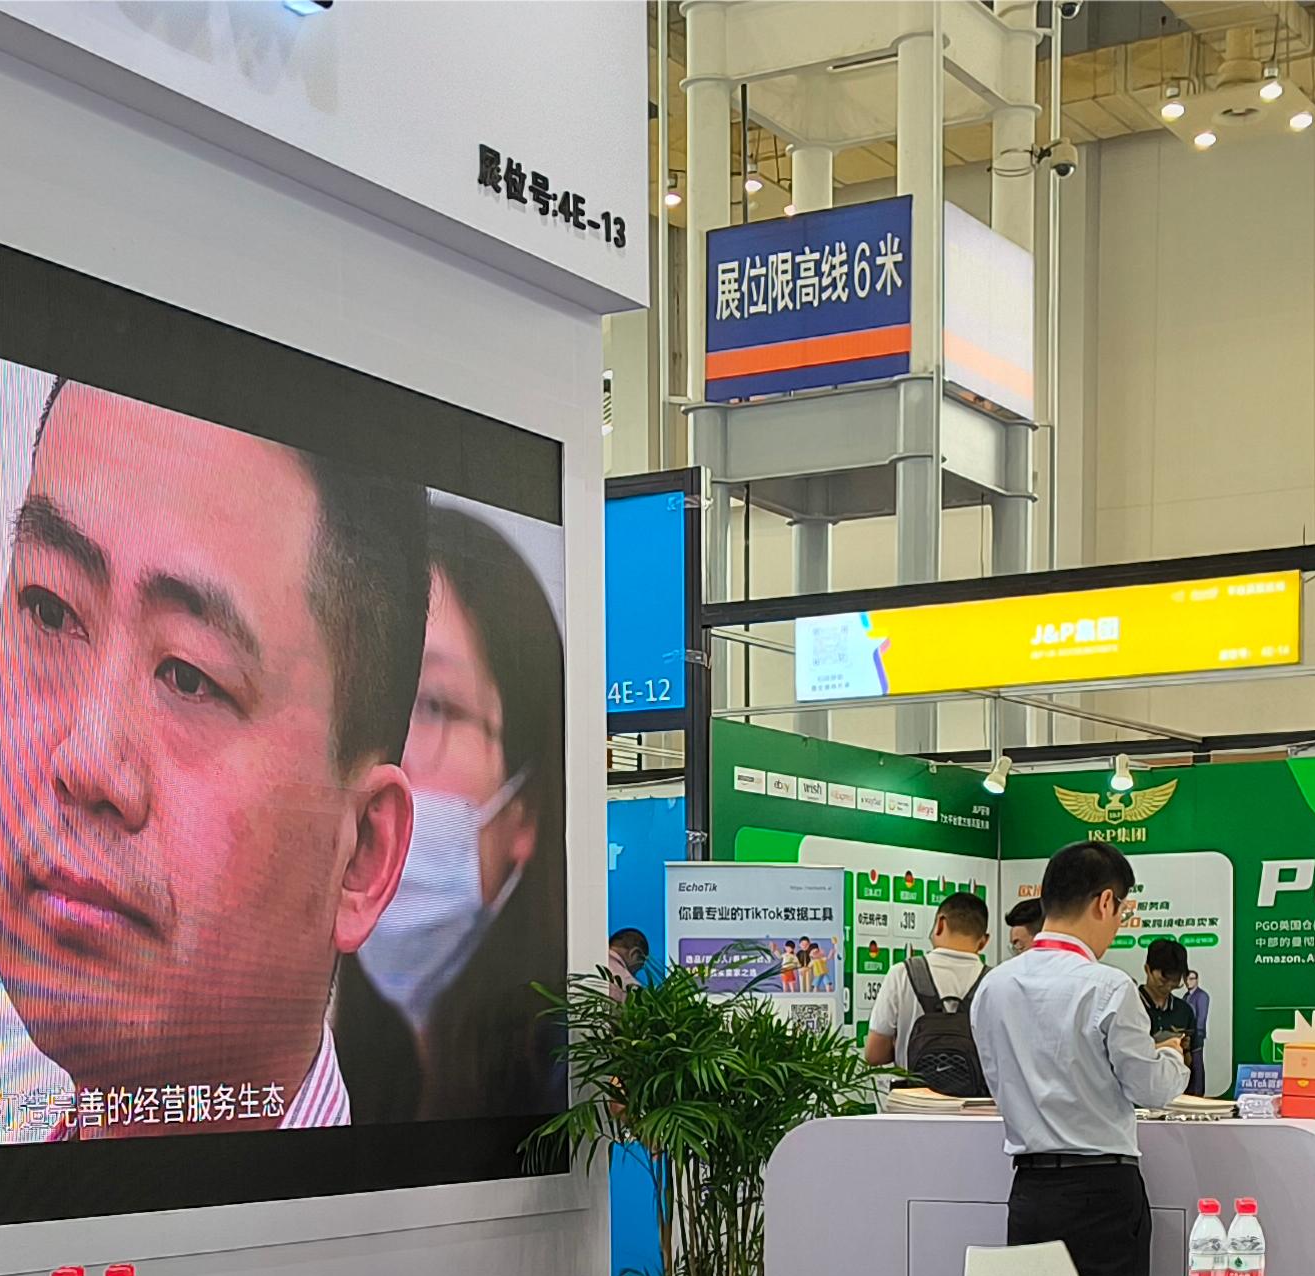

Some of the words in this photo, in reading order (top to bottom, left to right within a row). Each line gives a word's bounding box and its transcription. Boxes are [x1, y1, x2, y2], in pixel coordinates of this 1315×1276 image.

[716, 232, 903, 321] 展位限高线6米
[607, 678, 671, 704] 4E-12
[678, 882, 718, 893] EchoTik
[678, 906, 834, 922] 你最专业的TikTok数据工具
